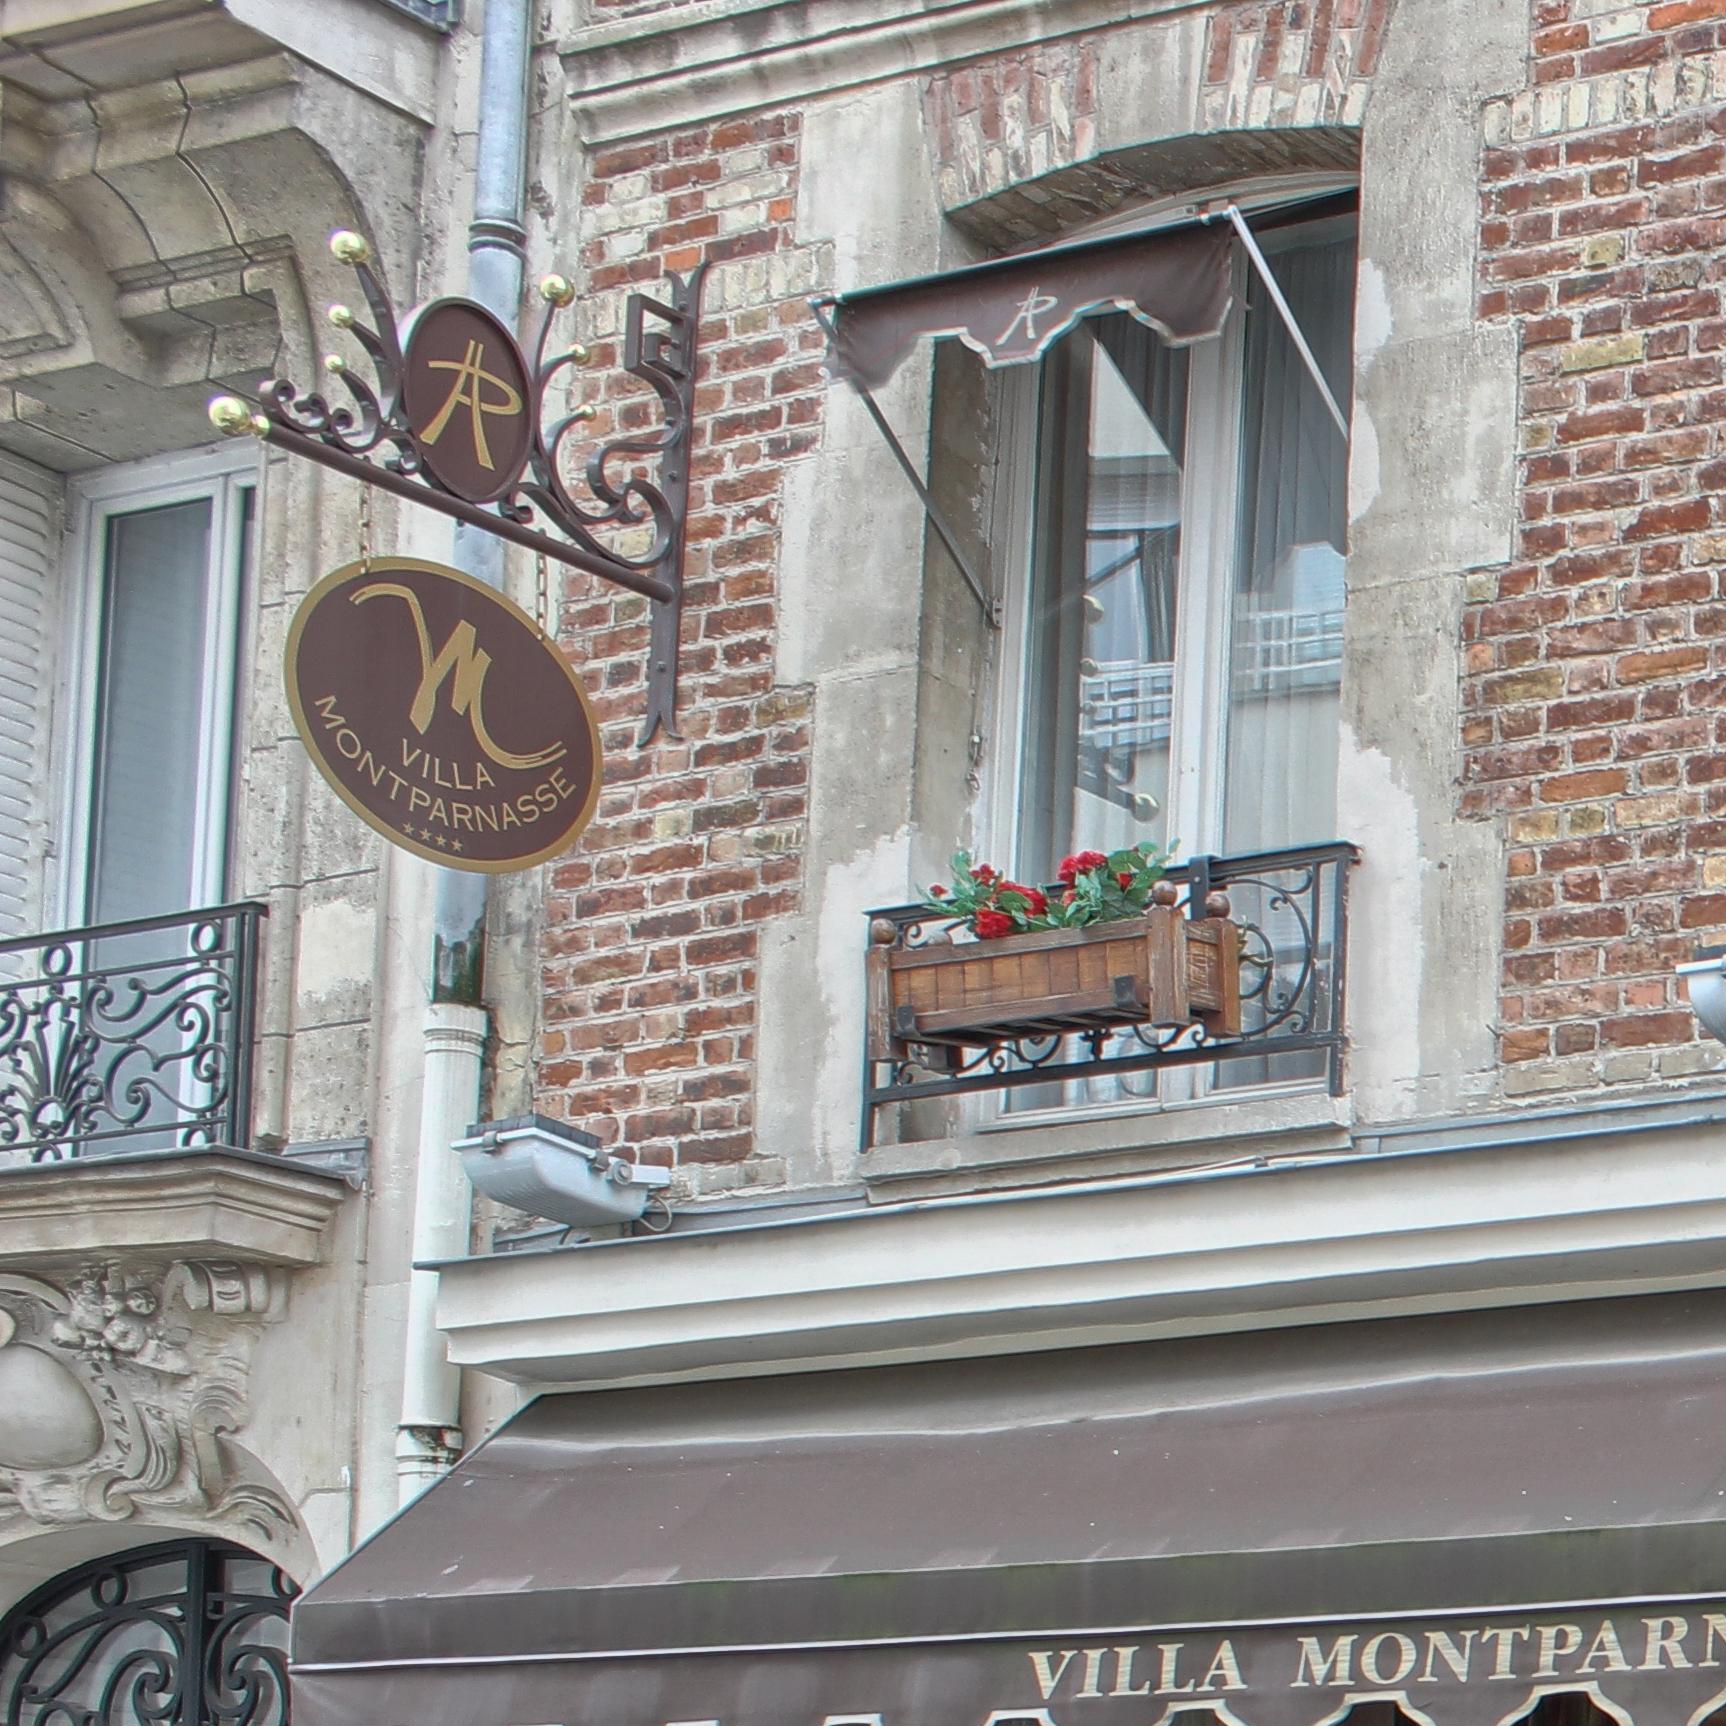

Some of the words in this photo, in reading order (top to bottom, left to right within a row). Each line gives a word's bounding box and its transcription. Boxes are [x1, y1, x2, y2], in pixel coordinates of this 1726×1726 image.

[315, 695, 577, 832] MONTPARNASSE
[402, 738, 496, 790] VILLA
[1028, 1639, 1249, 1700] VILLA
